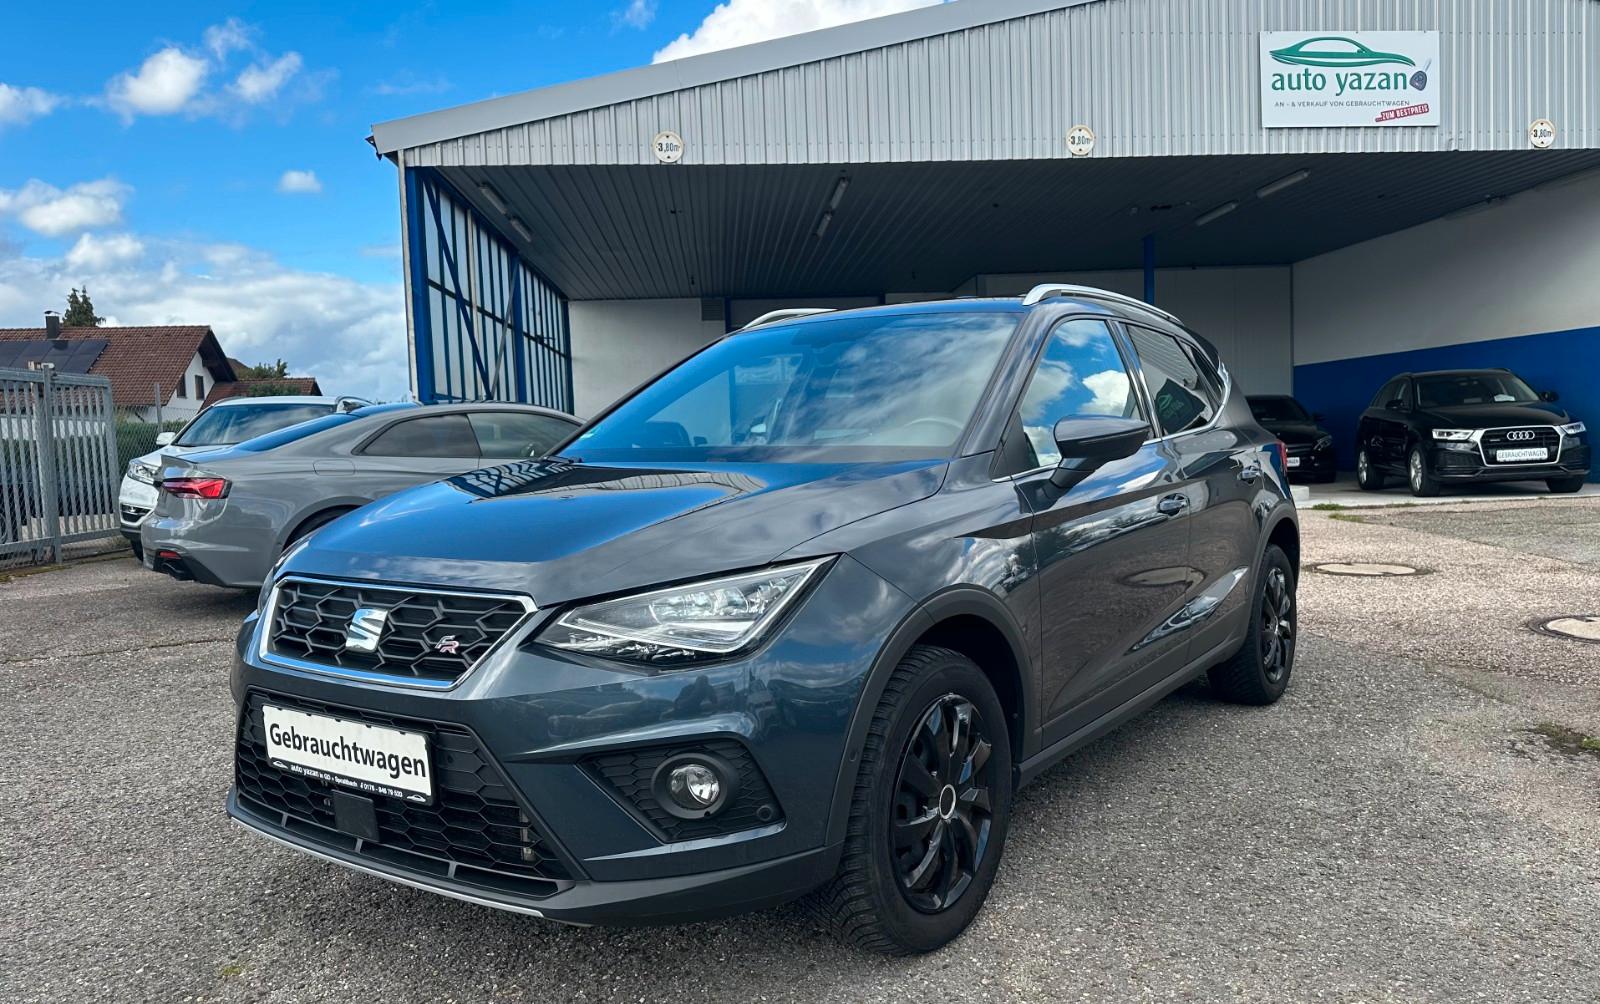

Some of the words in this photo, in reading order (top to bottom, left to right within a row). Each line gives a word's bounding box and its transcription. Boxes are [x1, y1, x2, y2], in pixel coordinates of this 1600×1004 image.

[1271, 68, 1326, 91] auto
[1335, 72, 1407, 96] yazan
[1396, 104, 1428, 117] BESTPREIS
[657, 142, 679, 153] 3,80m
[1498, 450, 1546, 458] GEBRAUCHTWAGEN
[269, 723, 426, 778] Gebrauchtwagen
[290, 764, 302, 773] auto
[303, 768, 320, 777] yazan
